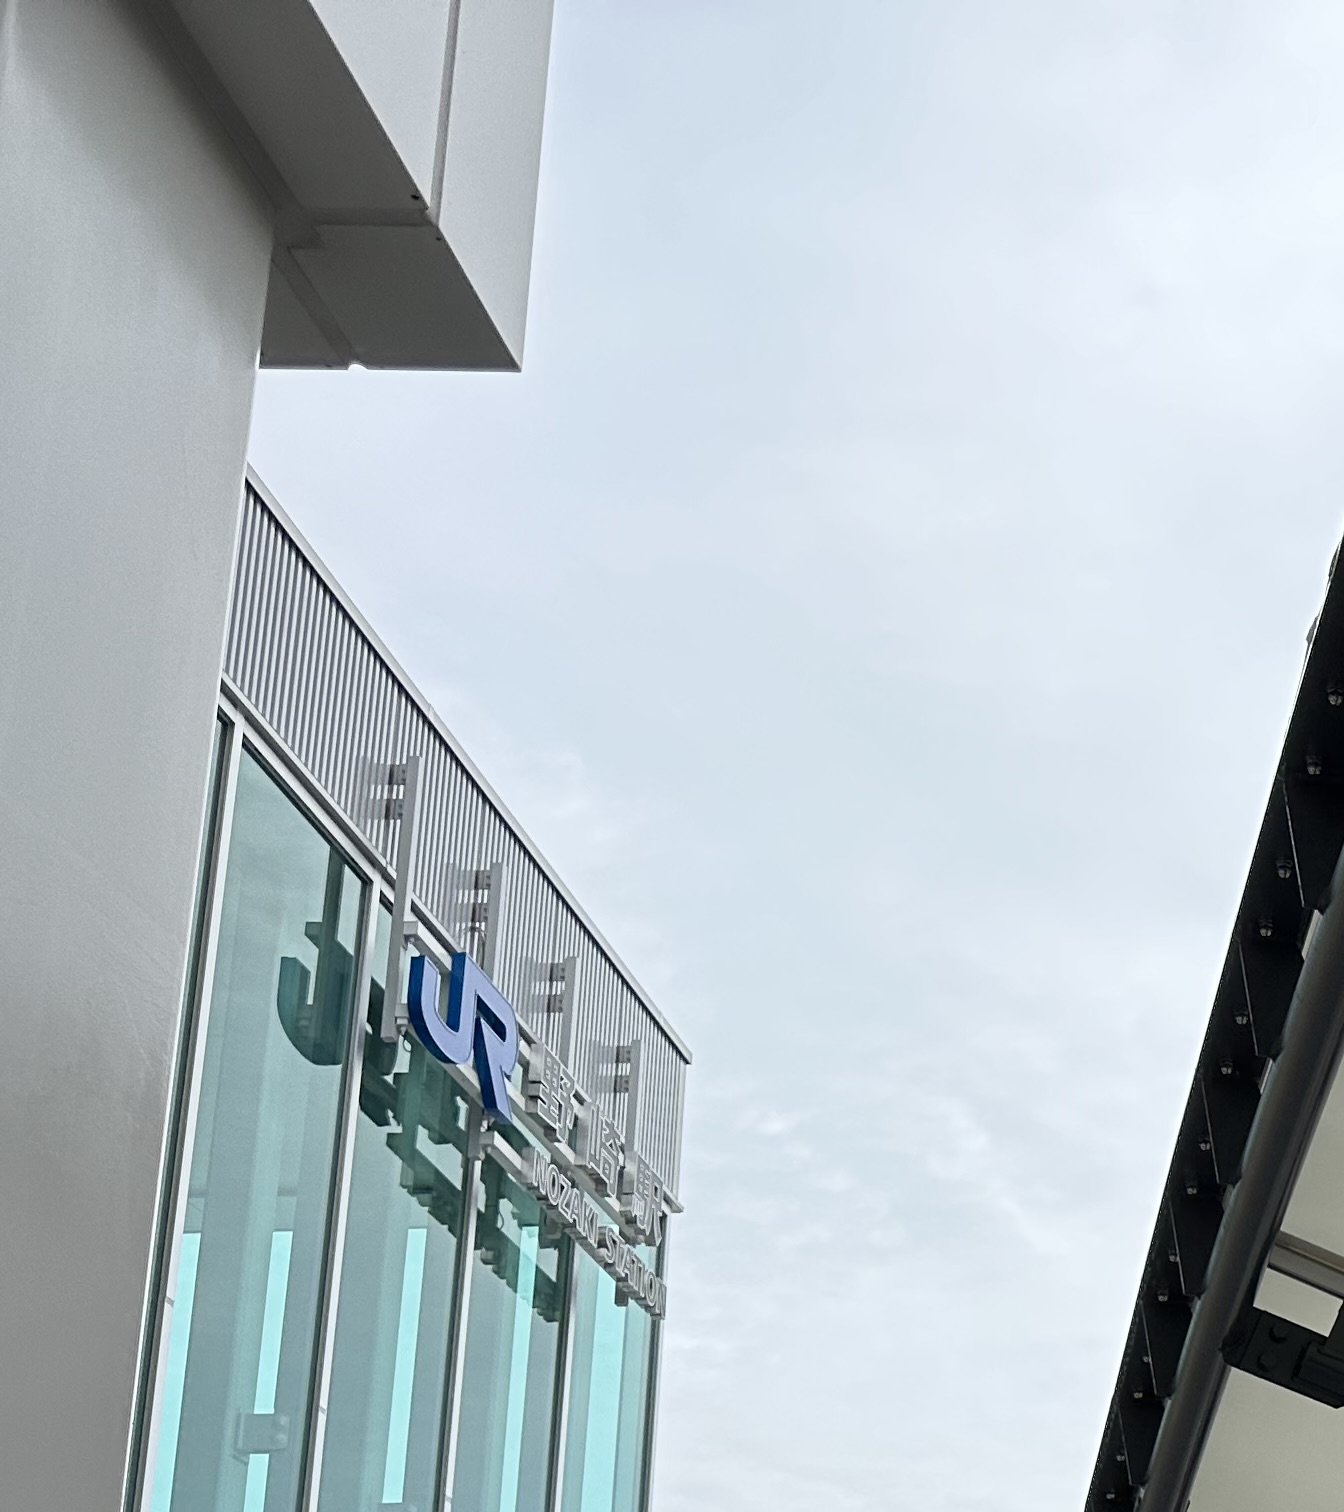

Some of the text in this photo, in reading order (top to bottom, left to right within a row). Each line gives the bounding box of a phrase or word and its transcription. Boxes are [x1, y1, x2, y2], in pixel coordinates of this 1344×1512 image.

[408, 952, 518, 1124] JR
[528, 1043, 664, 1247] 野崎駅
[526, 1149, 667, 1320] NOZAKI STATION
